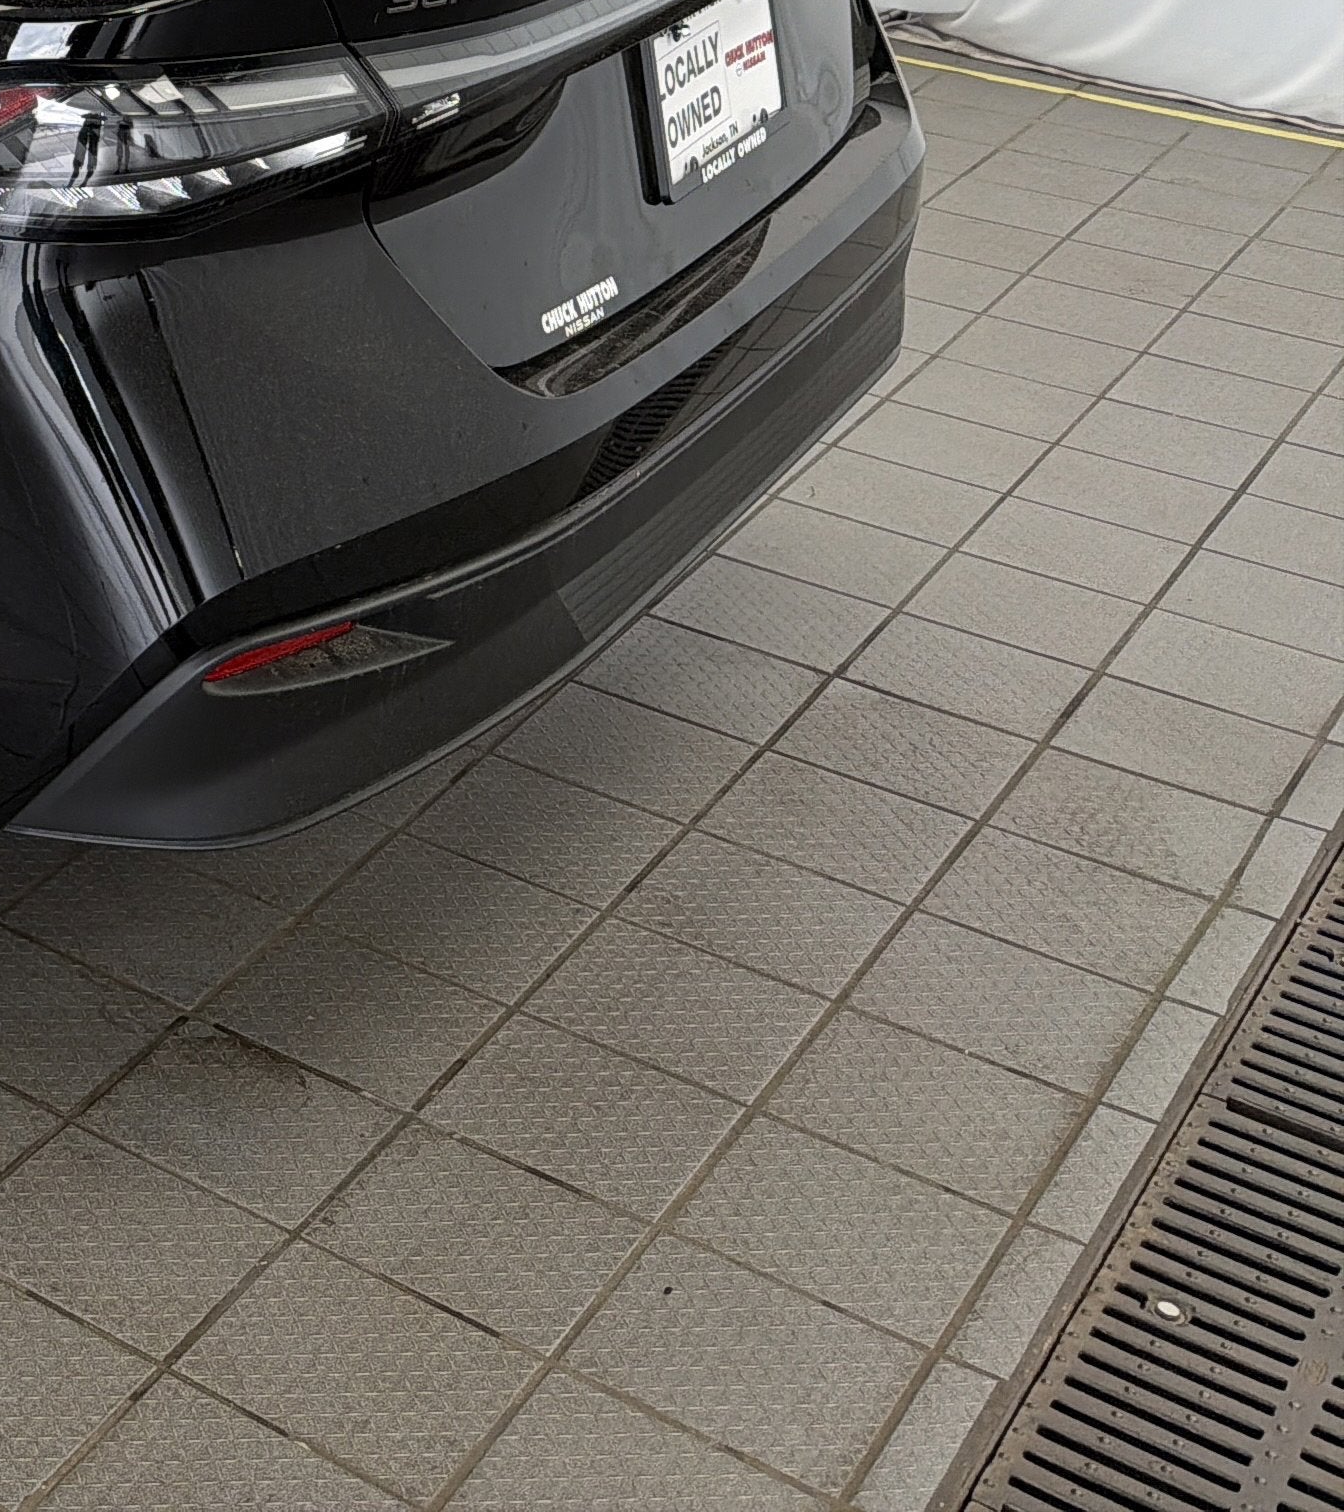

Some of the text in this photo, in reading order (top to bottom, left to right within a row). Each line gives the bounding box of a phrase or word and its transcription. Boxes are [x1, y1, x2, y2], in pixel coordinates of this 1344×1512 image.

[724, 28, 774, 67] CHUCK HUTTON
[743, 50, 766, 71] NISSAN
[668, 85, 722, 149] OWNED
[701, 126, 767, 184] LOCALLY OWNED
[702, 121, 739, 158] Jackson, TN
[541, 275, 619, 334] CHUCK HUTTON
[564, 306, 605, 338] NISSAN
